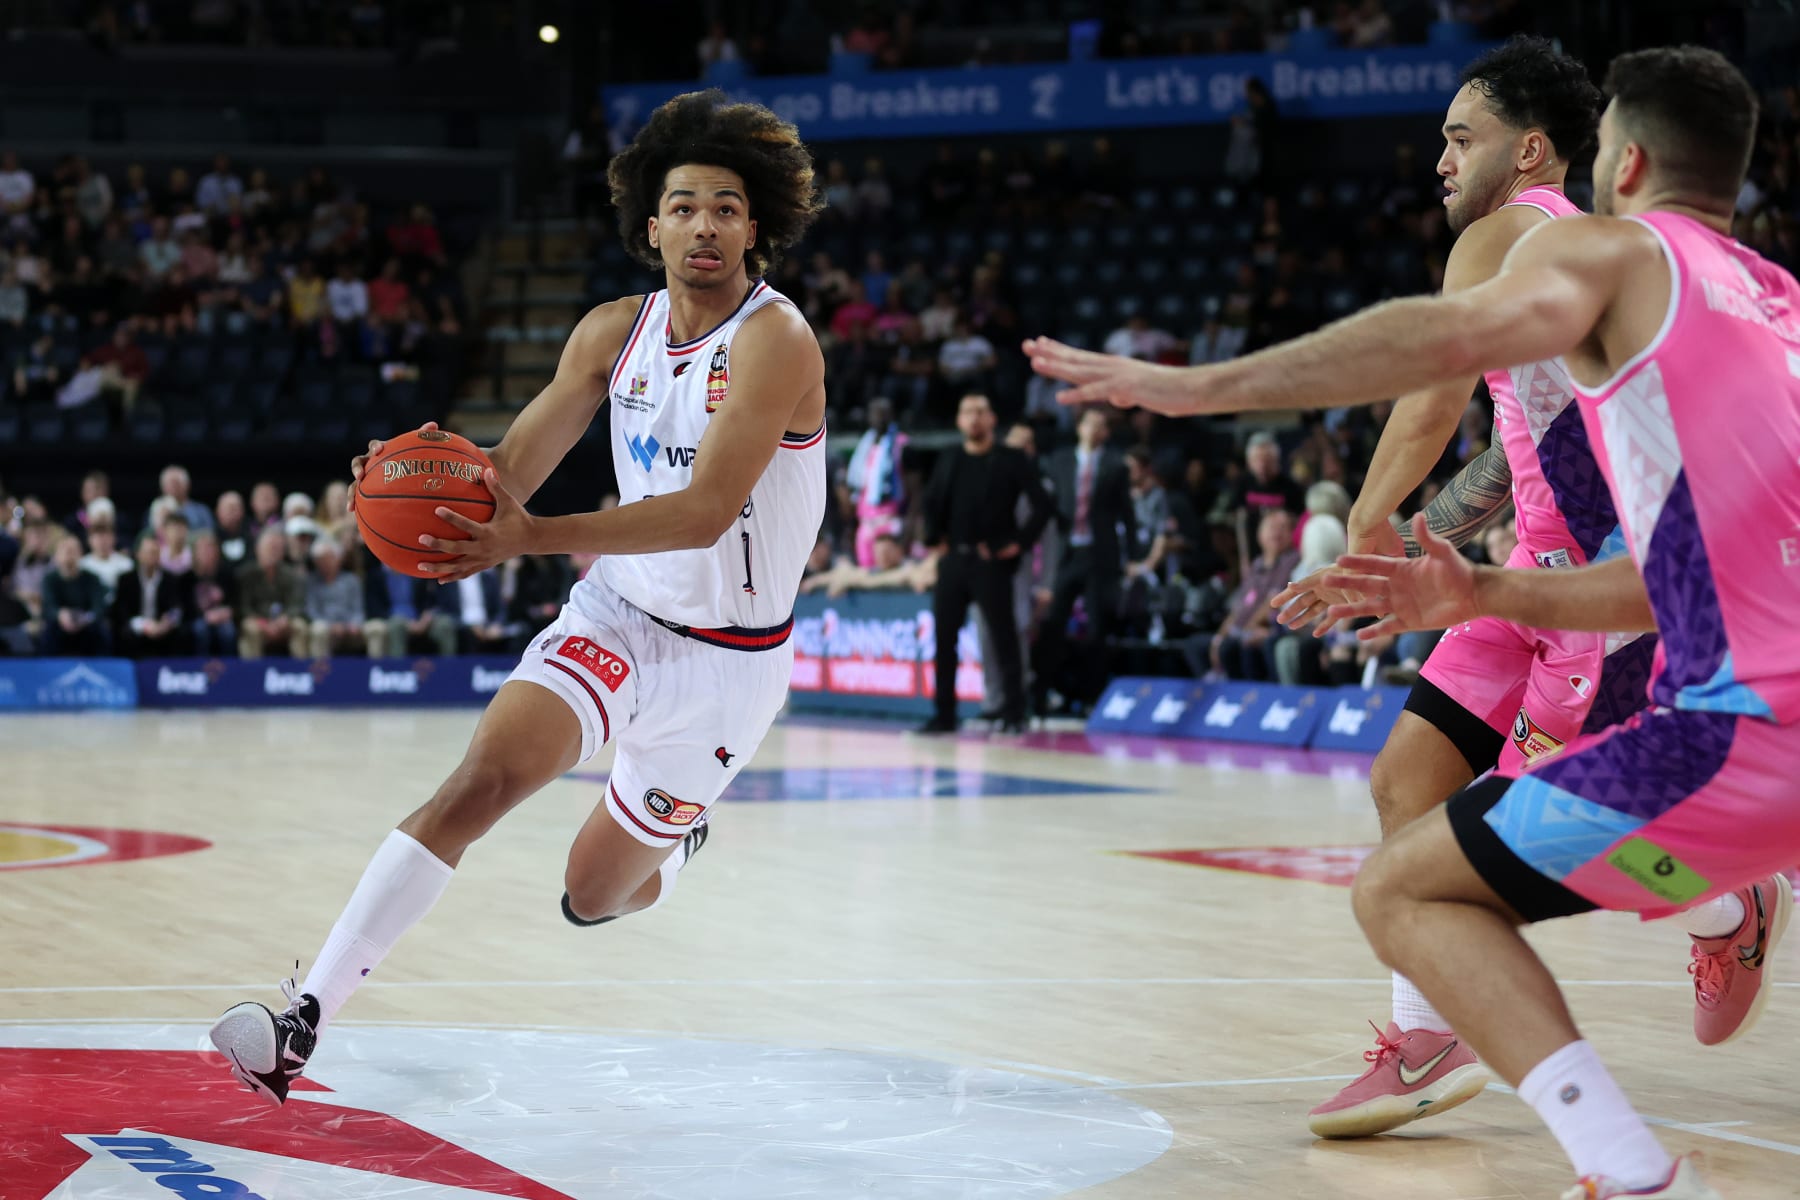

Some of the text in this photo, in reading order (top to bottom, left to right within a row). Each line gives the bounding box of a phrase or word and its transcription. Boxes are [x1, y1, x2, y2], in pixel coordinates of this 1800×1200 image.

[1105, 70, 1198, 108] Let's
[1272, 56, 1458, 98] Breakers
[830, 81, 999, 120] Breakers
[384, 459, 483, 486] SPALDING
[564, 648, 616, 685] FITNESS
[569, 640, 623, 676] REVO
[649, 794, 668, 813] NBL
